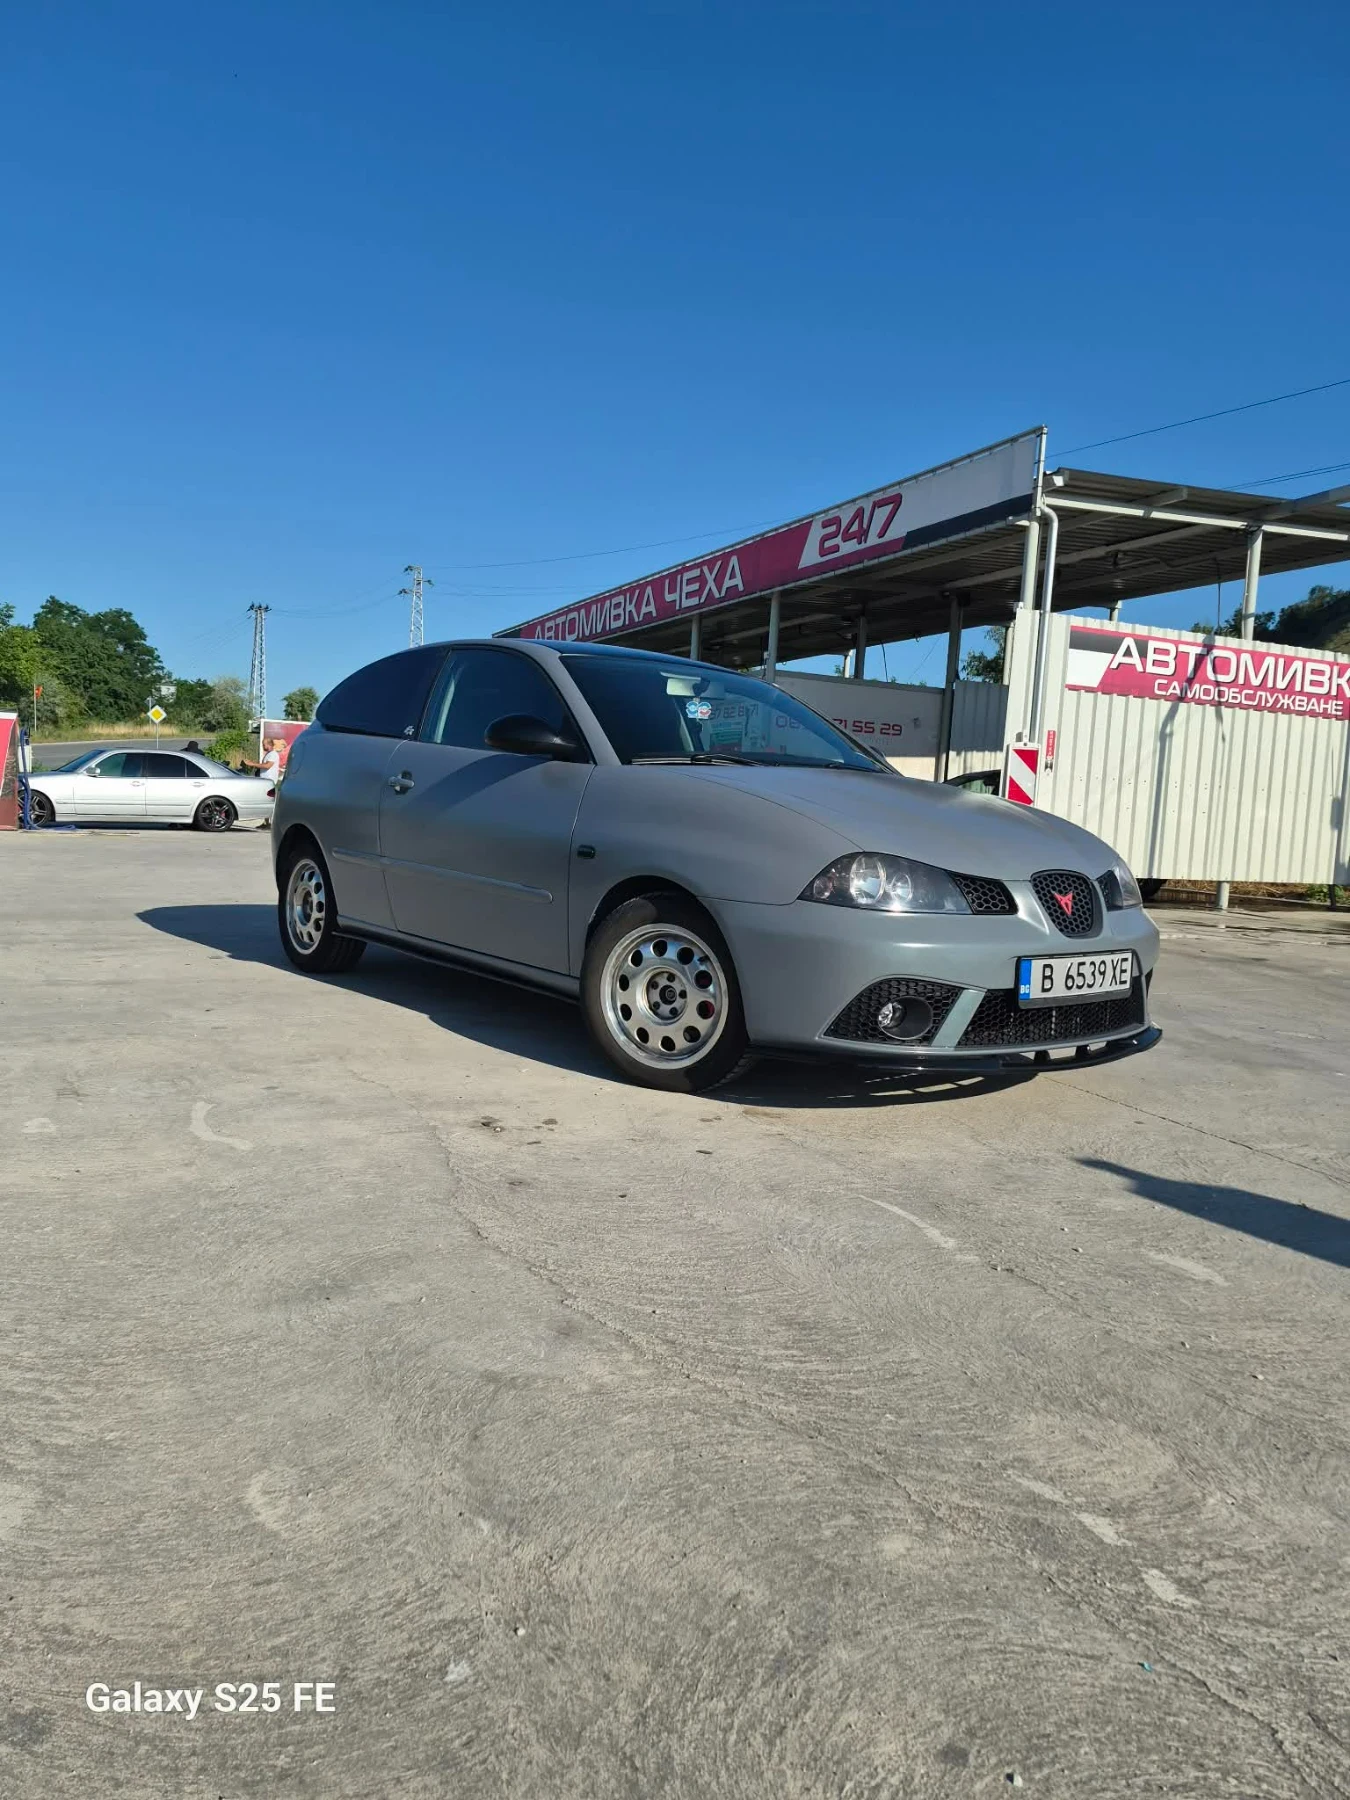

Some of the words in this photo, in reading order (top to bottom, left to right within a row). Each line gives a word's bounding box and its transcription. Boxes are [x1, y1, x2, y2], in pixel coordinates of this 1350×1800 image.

[818, 492, 902, 558] 24/7
[534, 586, 657, 641] АВТОМИВКА
[664, 555, 744, 610] ЧЕХА
[1110, 637, 1350, 698] АВТОМИВК
[1154, 679, 1343, 716] САМООБСЛУЖВАНЕ
[852, 719, 875, 734] 55
[880, 722, 903, 736] 29
[1041, 963, 1054, 993] B
[1064, 960, 1107, 991] 6539
[1109, 957, 1129, 987] XE
